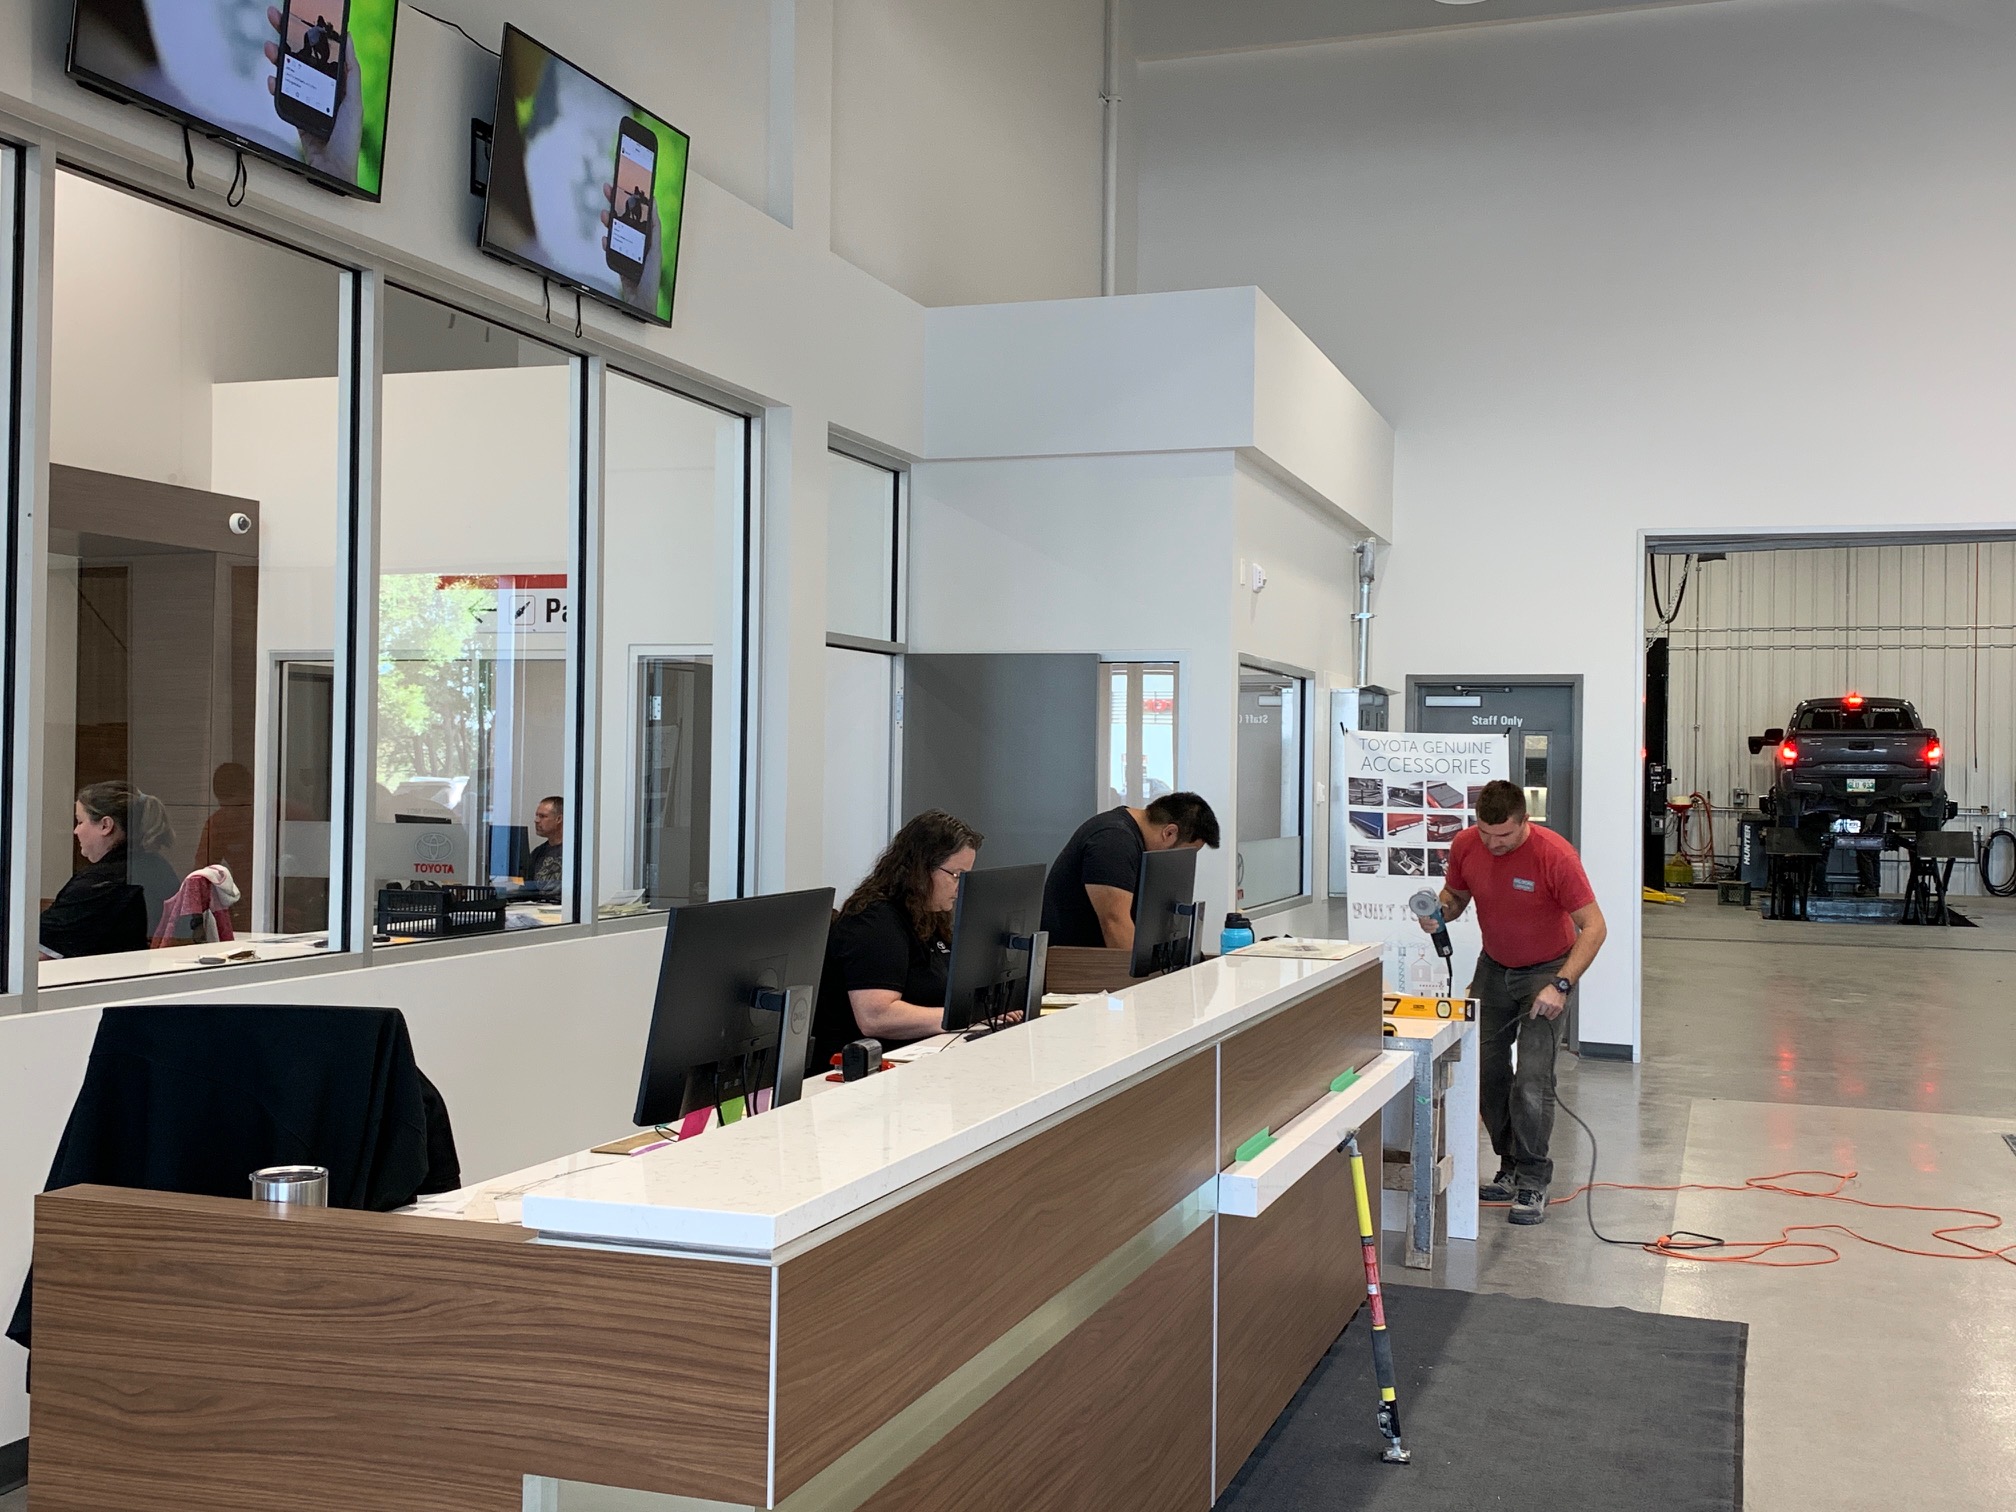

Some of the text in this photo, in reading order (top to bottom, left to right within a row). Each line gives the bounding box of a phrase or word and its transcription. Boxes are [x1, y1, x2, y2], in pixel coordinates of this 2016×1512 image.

[1471, 715, 1523, 728] Staff Only
[1359, 738, 1493, 755] TOYOTA GENUINE
[1361, 756, 1491, 775] ACCESSORIES
[1743, 824, 1752, 866] HUNTER
[413, 863, 455, 874] TOYOTA
[1352, 902, 1396, 920] BUILT
